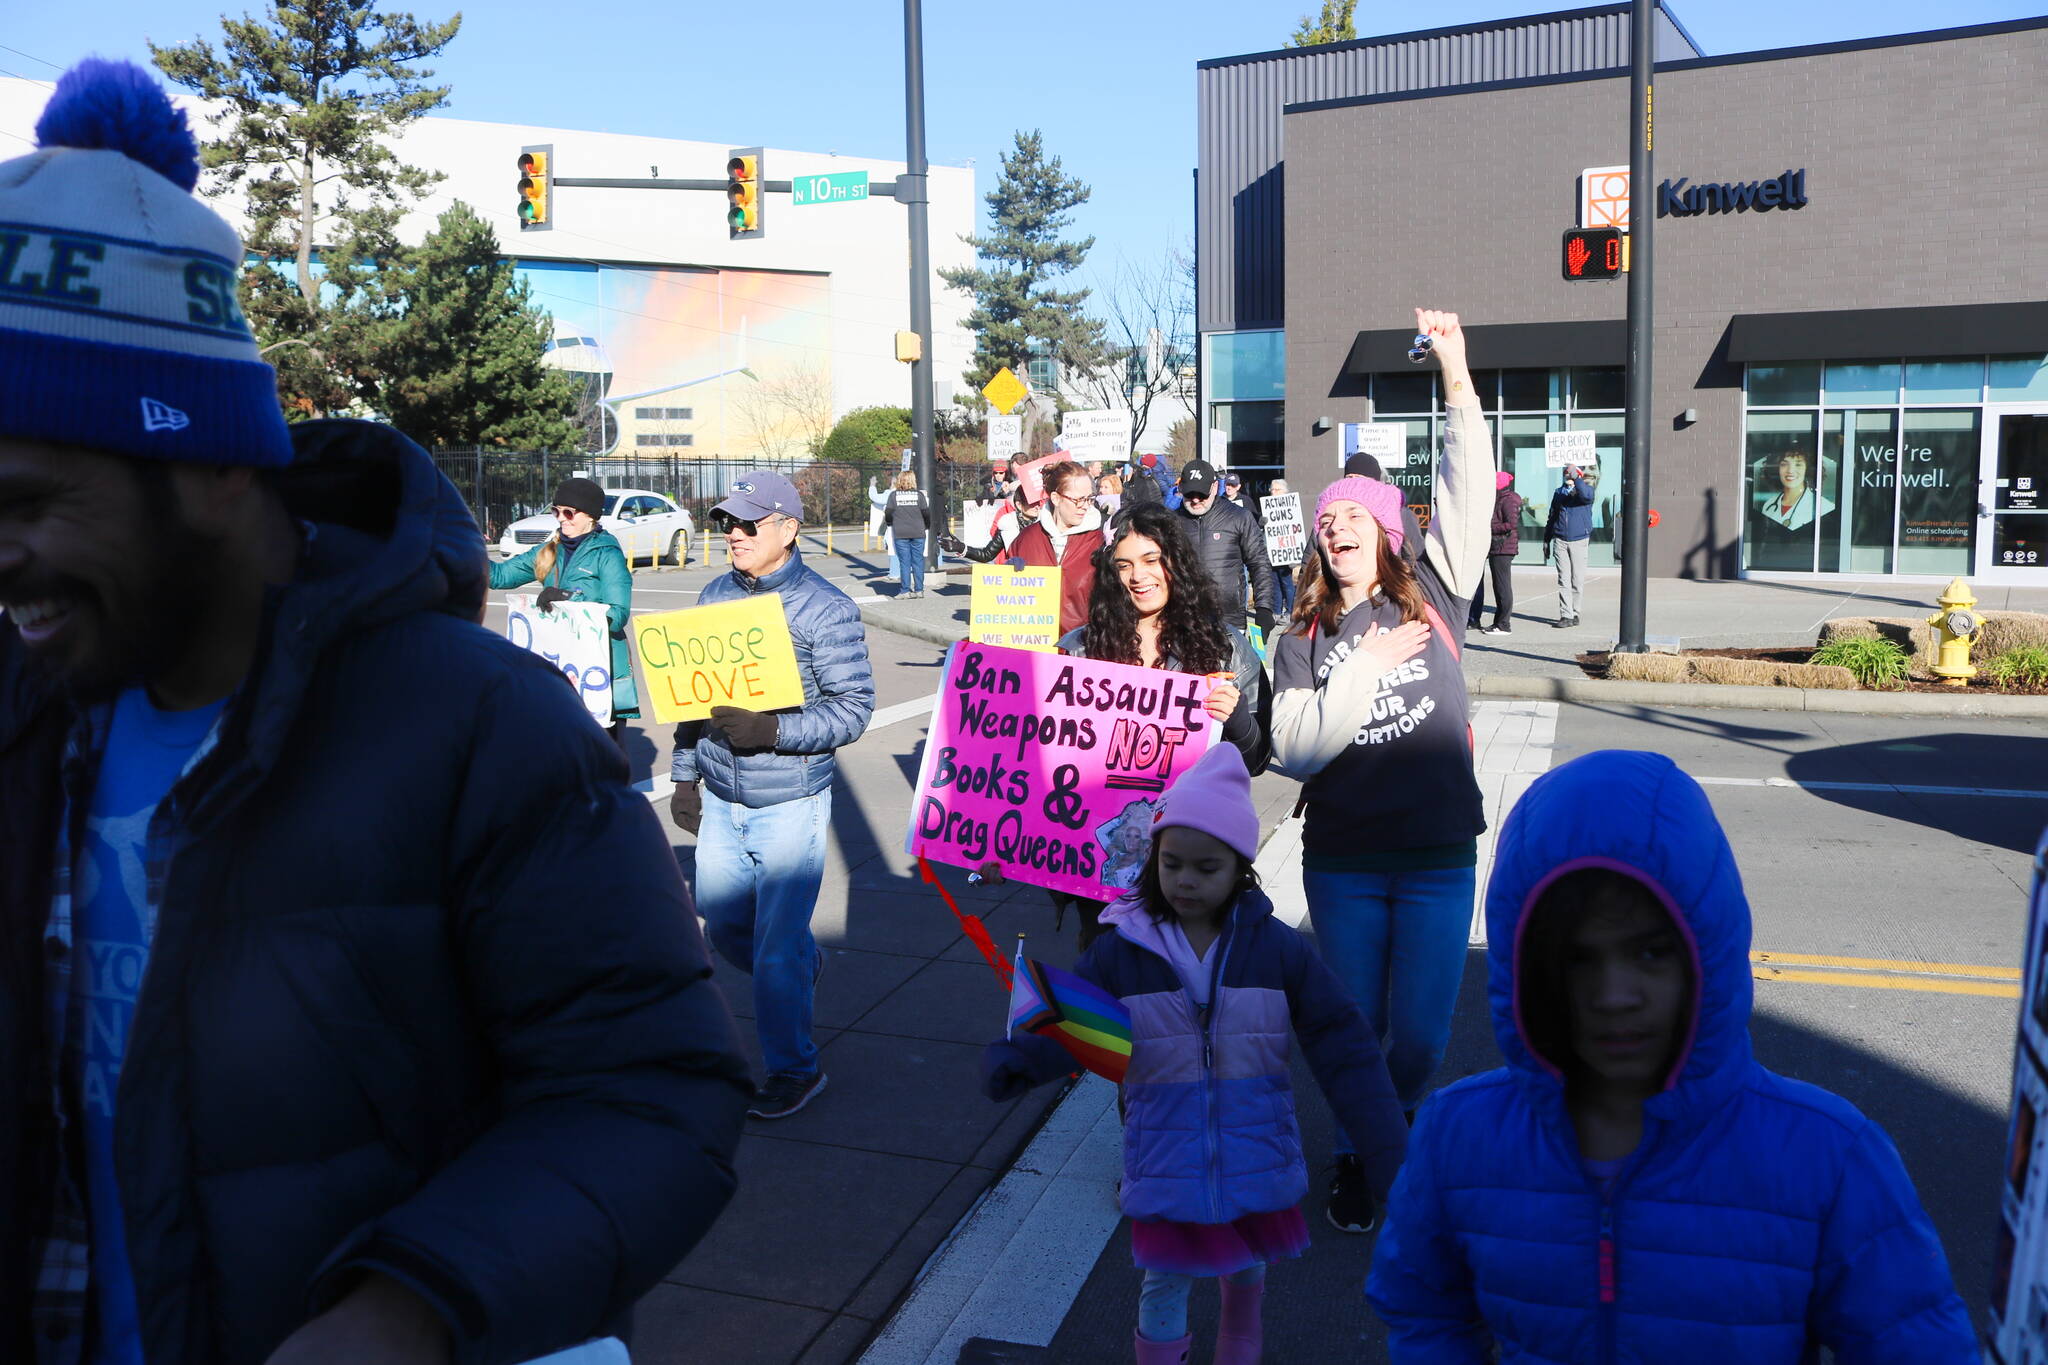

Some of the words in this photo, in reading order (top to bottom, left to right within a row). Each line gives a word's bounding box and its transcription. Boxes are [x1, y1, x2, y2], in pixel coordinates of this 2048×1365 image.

[795, 190, 804, 202] N
[809, 177, 847, 200] 10TH
[851, 184, 866, 197] ST
[1658, 168, 1808, 216] Kinwell
[1090, 416, 1122, 425] Renton
[1064, 431, 1089, 440] Stand
[1548, 436, 1565, 448] HER
[1567, 434, 1591, 447] BODY
[1548, 449, 1565, 462] HER
[1566, 448, 1593, 461] CHOICE
[1269, 508, 1293, 522] GUNS
[1291, 523, 1302, 534] DO
[1906, 527, 1930, 535] Online
[1930, 527, 1969, 537] scheduling
[1271, 541, 1304, 563] PEOPLE!
[982, 575, 1003, 586] WE
[1010, 577, 1045, 587] DONT
[996, 595, 1035, 605] WANT
[975, 614, 1054, 625] GREENLAND
[982, 633, 1003, 644] WE
[1011, 634, 1050, 645] WANT
[639, 625, 767, 669] Choose
[667, 662, 765, 707] LOVE
[955, 651, 1021, 694] Ban
[1045, 665, 1204, 732] Assault
[959, 693, 1097, 762] Weapons
[1106, 718, 1188, 779] NOT
[930, 746, 1030, 806] Books
[1042, 763, 1090, 830] &
[918, 795, 988, 862] Drag
[994, 808, 1096, 878] Queens
